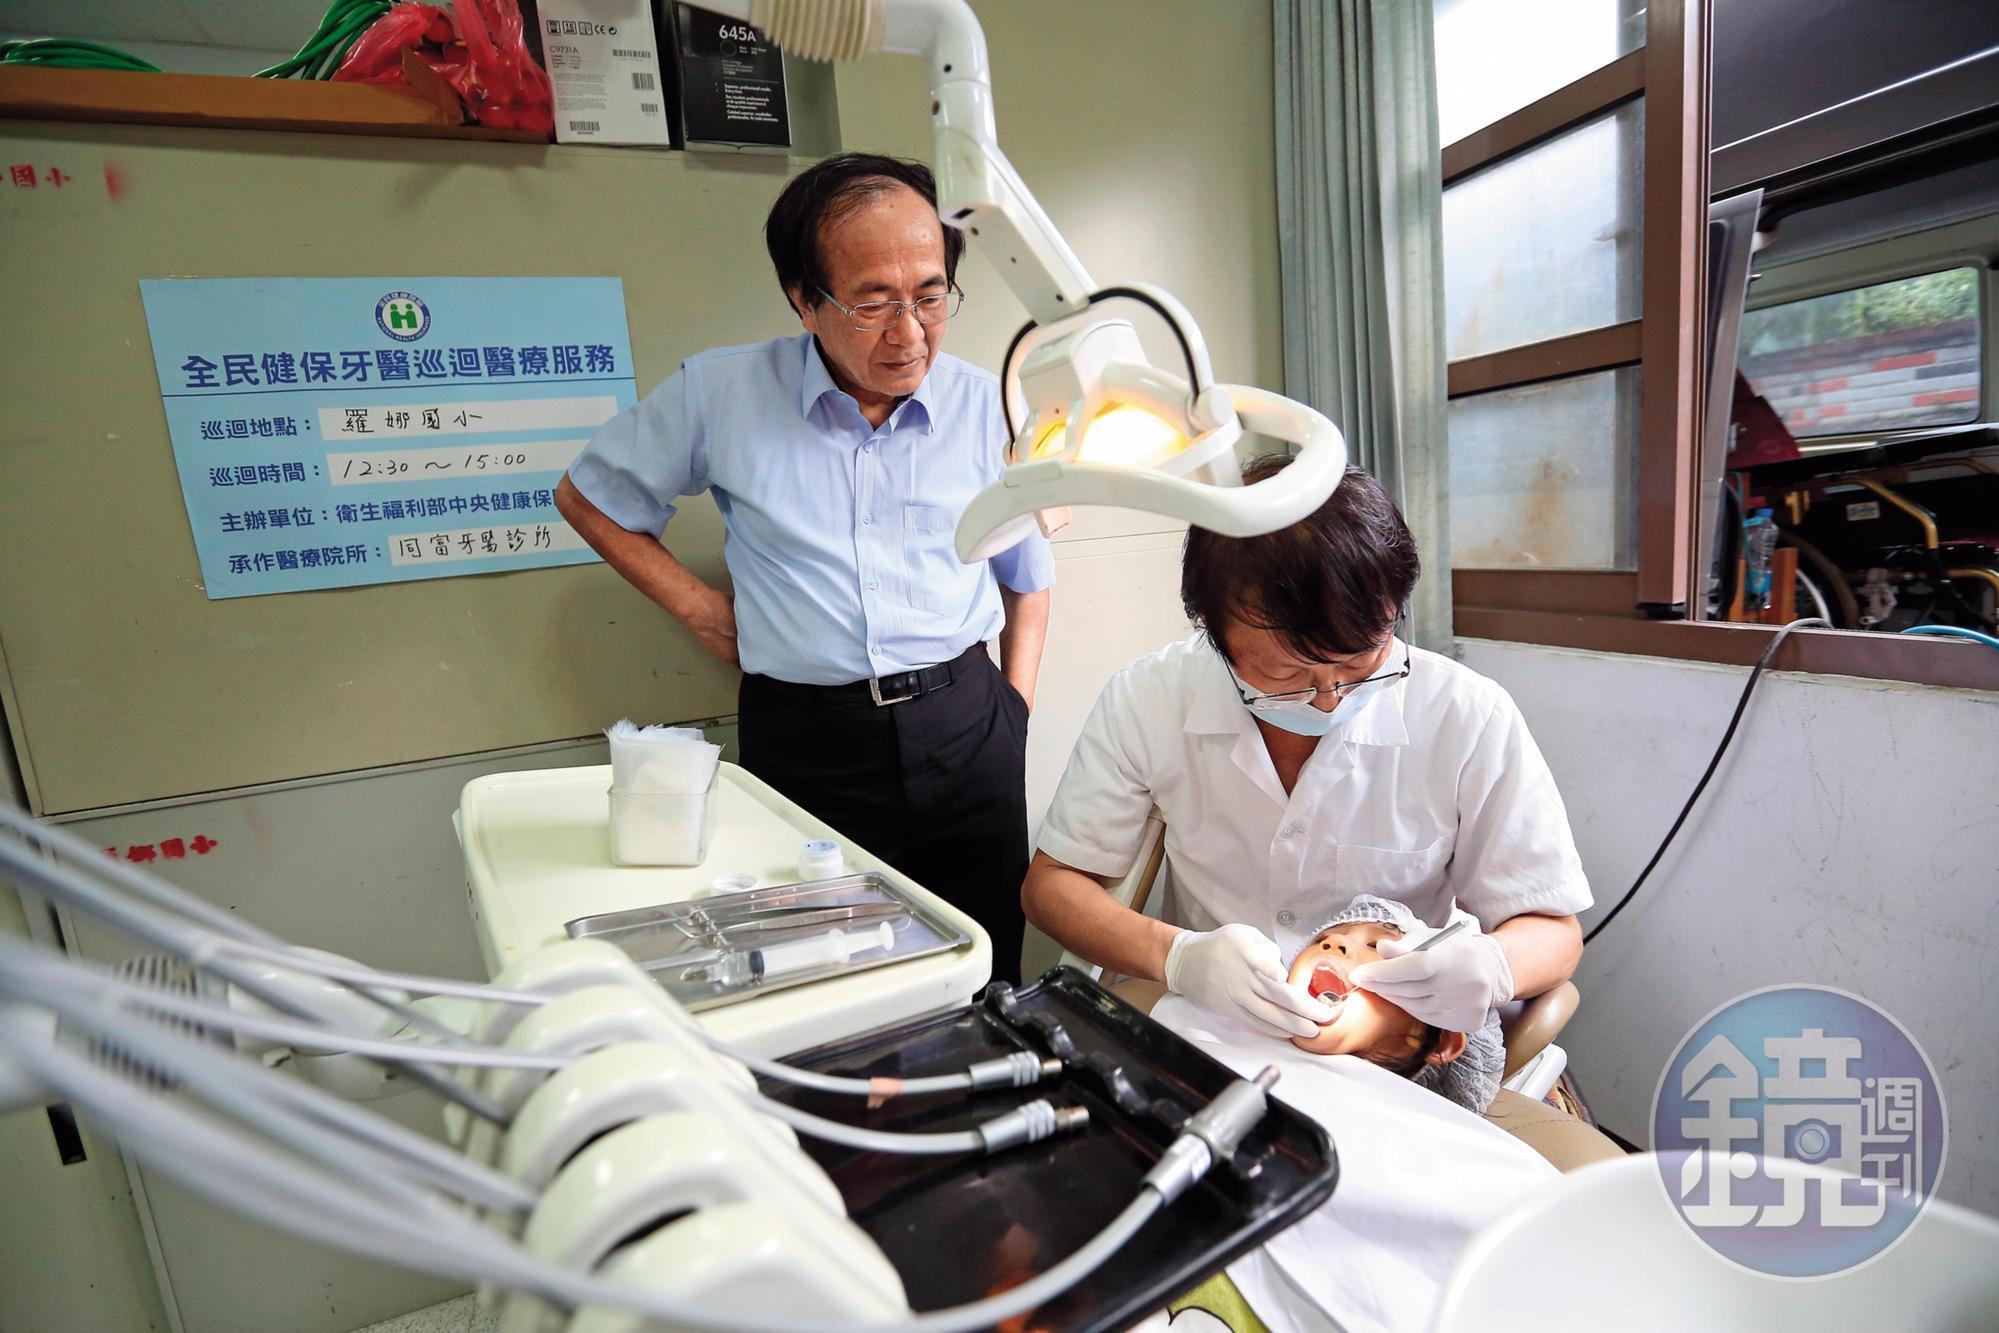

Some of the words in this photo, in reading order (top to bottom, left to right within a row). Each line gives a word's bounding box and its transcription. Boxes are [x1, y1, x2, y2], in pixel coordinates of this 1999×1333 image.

[719, 24, 757, 42] 645A
[181, 344, 615, 388] 全民健保牙醫巡迴醫療服務
[342, 408, 483, 433] 羅娜國小
[343, 459, 409, 479] 12:30
[464, 453, 526, 470] 15:00
[220, 489, 557, 532] 主辦單位：衛生福利部中央健康保
